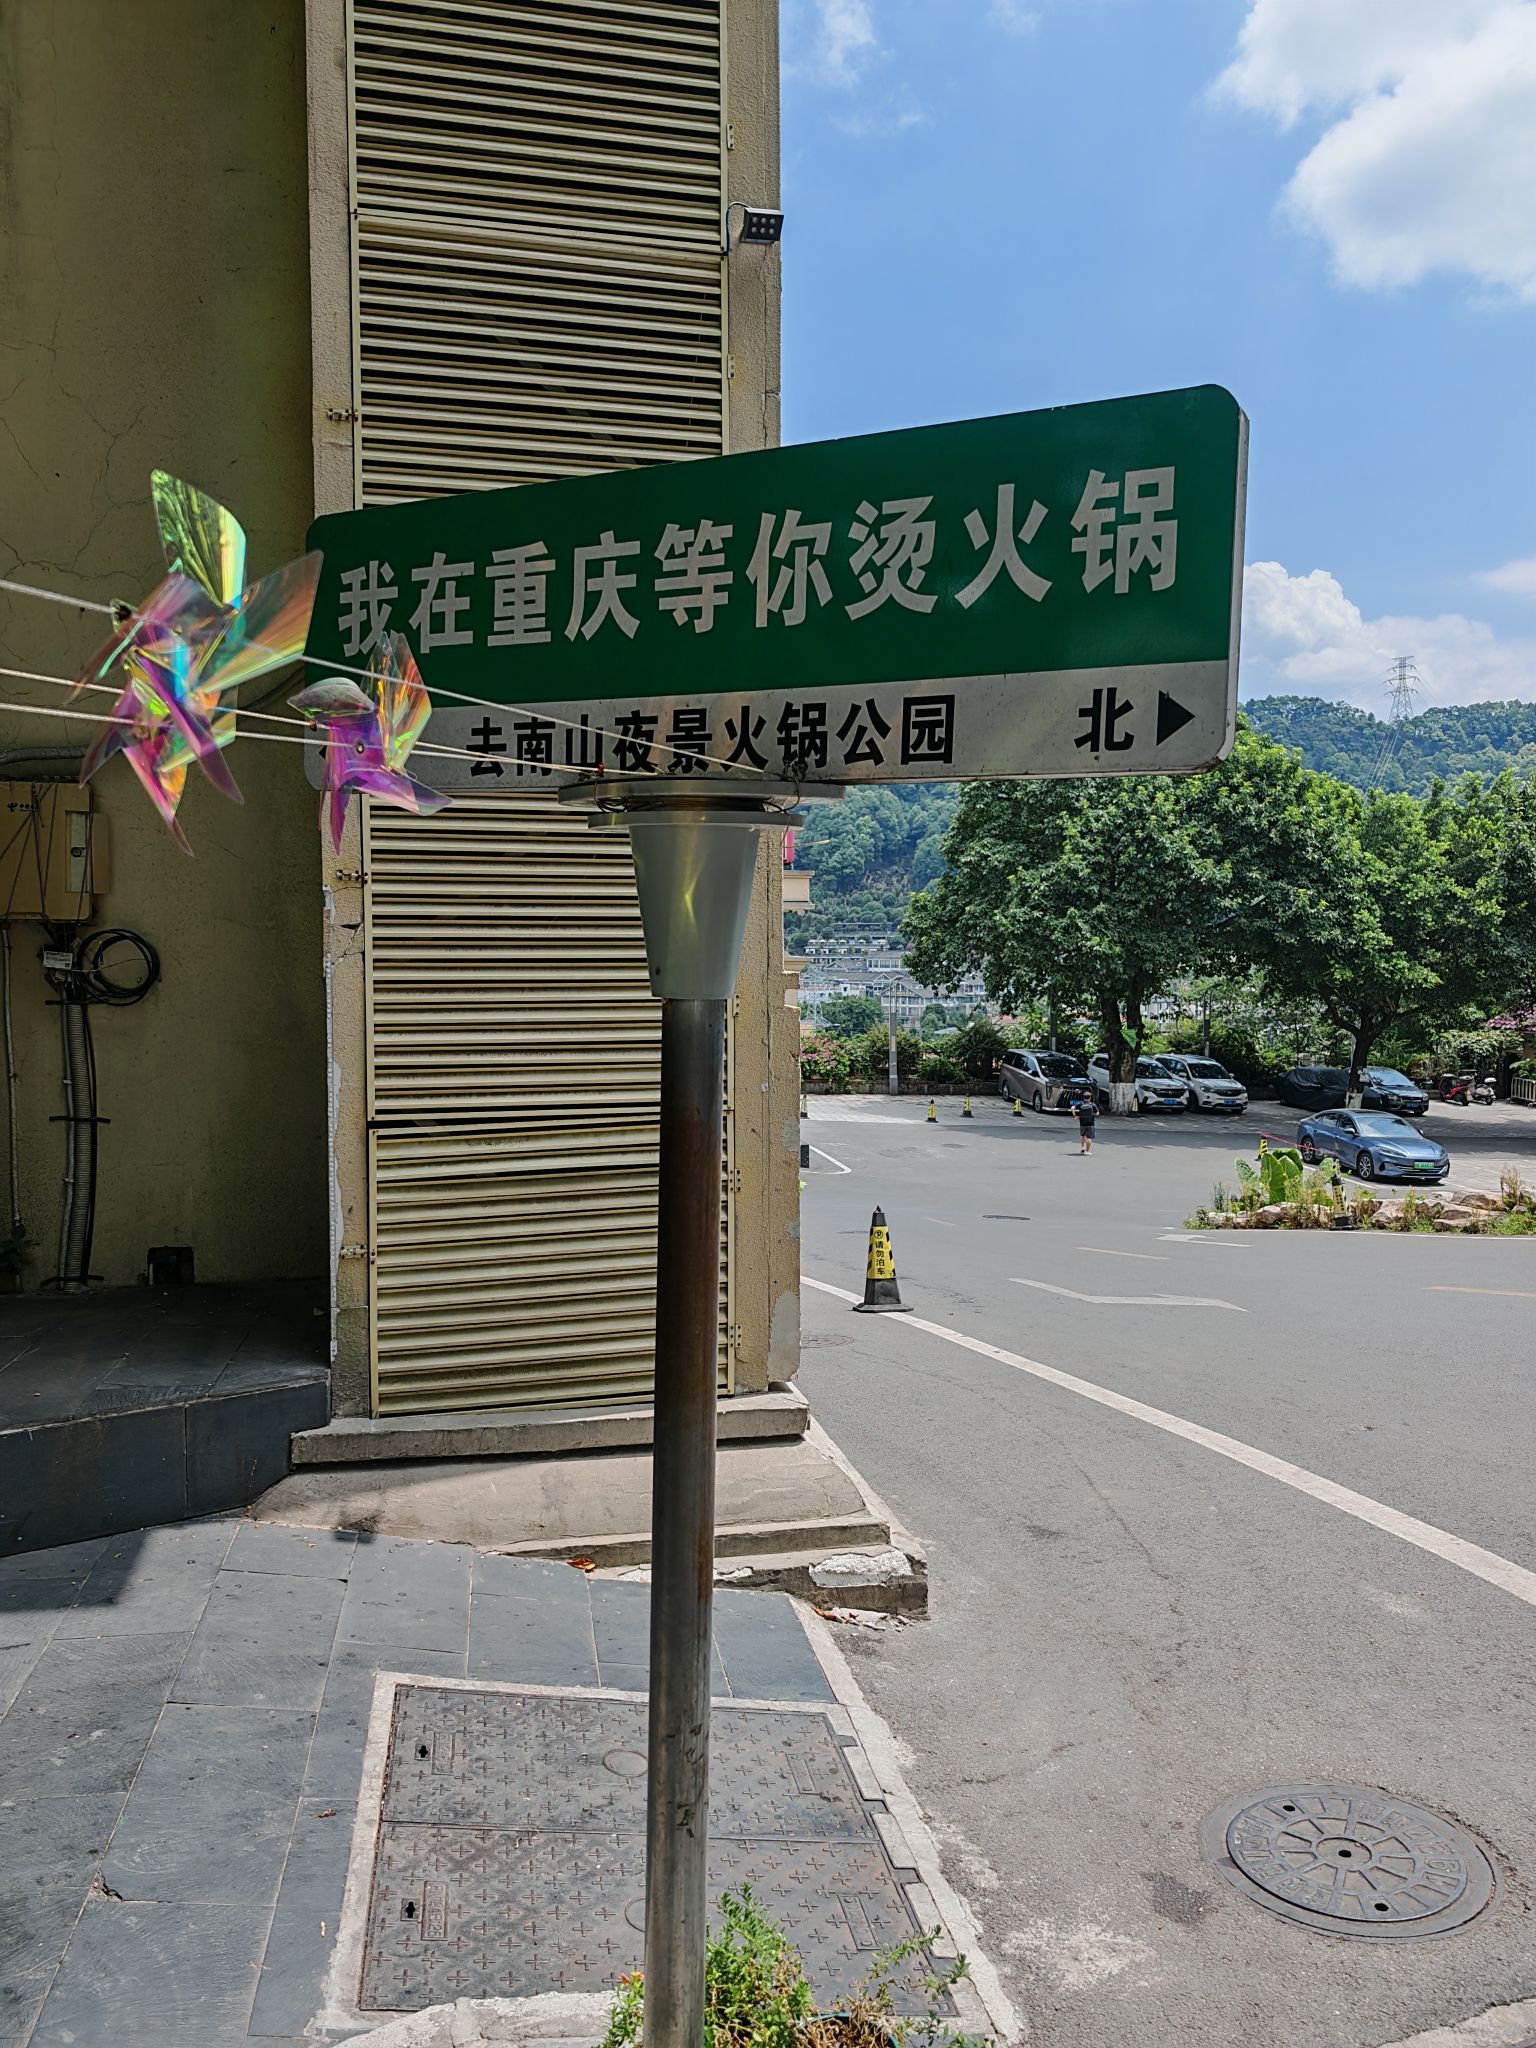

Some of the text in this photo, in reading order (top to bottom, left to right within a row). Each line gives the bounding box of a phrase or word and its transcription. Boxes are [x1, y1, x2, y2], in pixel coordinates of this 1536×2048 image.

[338, 466, 1178, 657] 我在重庆等你烫火锅
[466, 687, 1134, 778] 去南山夜景火锅公园 北
[875, 1240, 885, 1275] 请勿泊车
